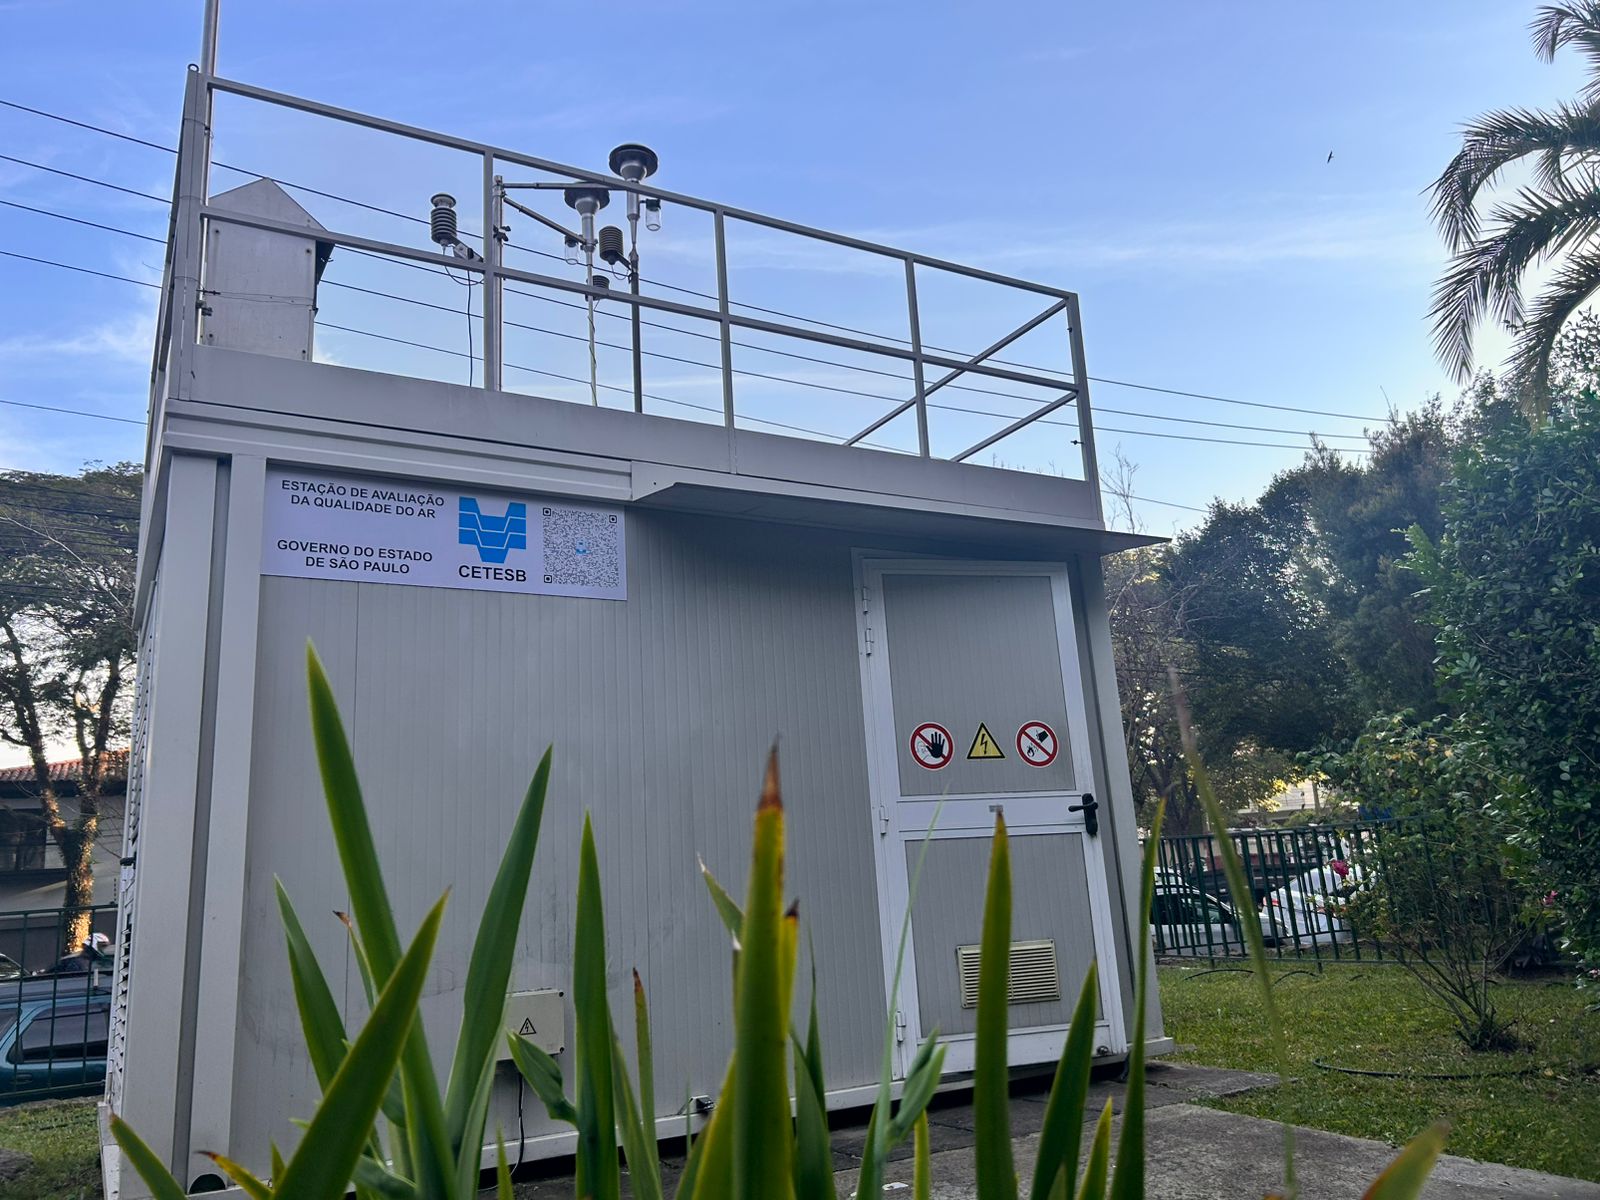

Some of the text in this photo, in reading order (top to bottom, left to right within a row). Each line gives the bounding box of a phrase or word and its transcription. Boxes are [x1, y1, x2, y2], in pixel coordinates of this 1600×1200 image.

[281, 480, 445, 507] ESTAÇÃO DE AVALIAÇÃO
[291, 495, 436, 519] DA QUALIDADE DO AR
[277, 539, 433, 562] GOVERNO DO ESTADO
[305, 556, 410, 574] DE SÃO PAULO
[458, 565, 527, 582] CETESB
